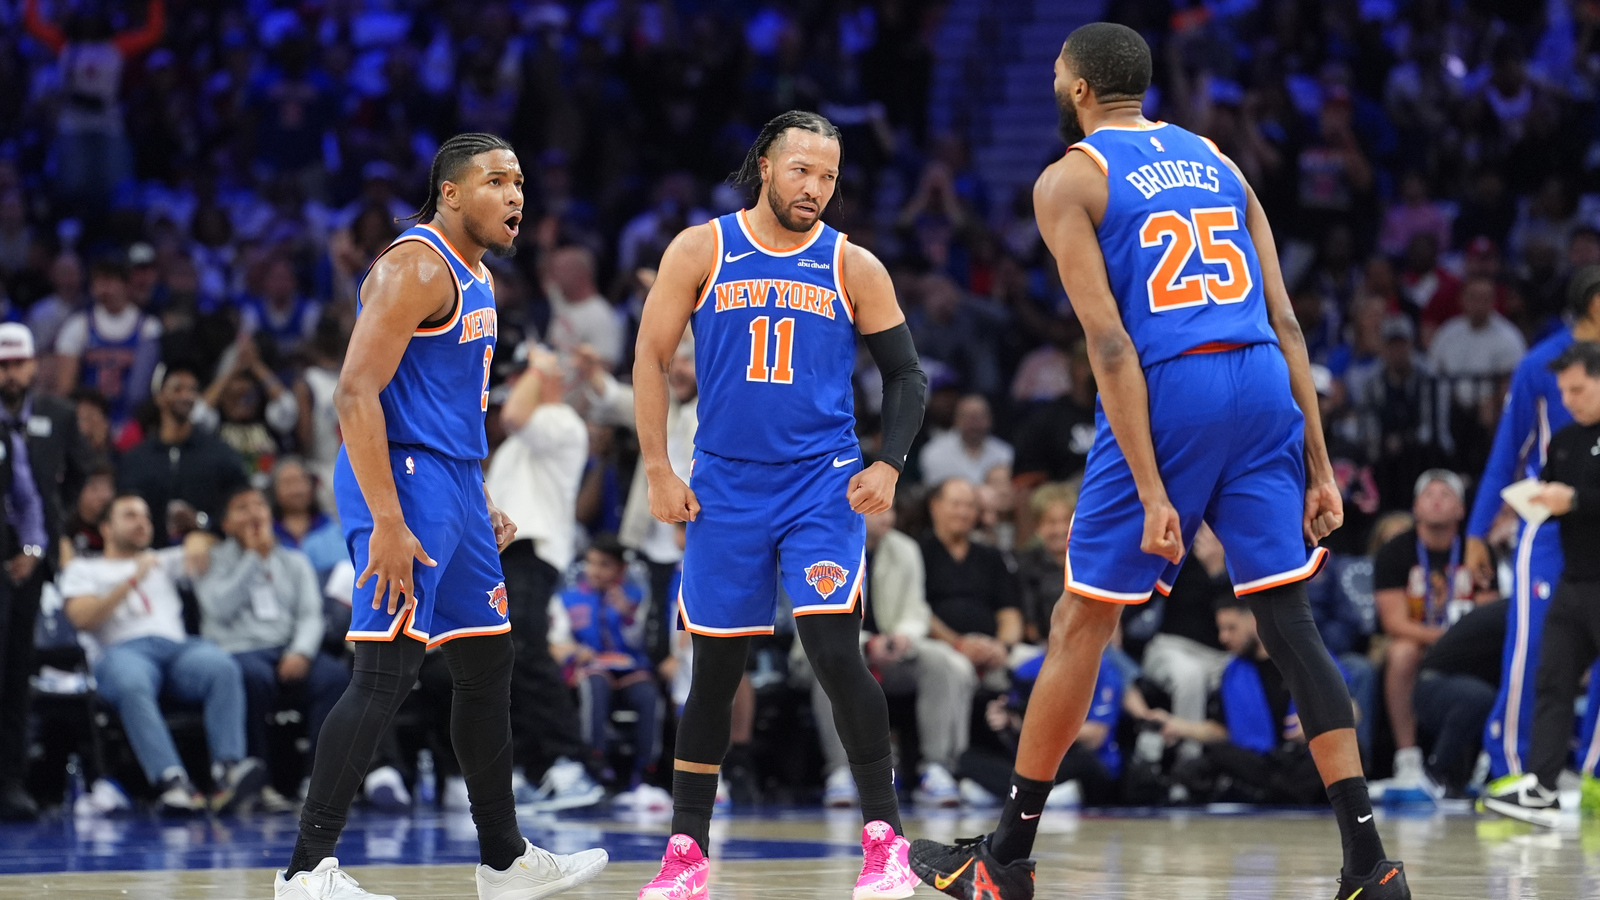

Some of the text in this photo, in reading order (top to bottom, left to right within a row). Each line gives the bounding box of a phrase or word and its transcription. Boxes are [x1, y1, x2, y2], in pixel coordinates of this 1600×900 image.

[1126, 160, 1220, 200] BRIDGES
[810, 262, 830, 270] dhabi
[1139, 206, 1253, 313] 25
[715, 278, 837, 321] NEW YORK
[746, 315, 796, 385] 11
[481, 345, 494, 412] 2
[807, 564, 846, 582] KNICKS
